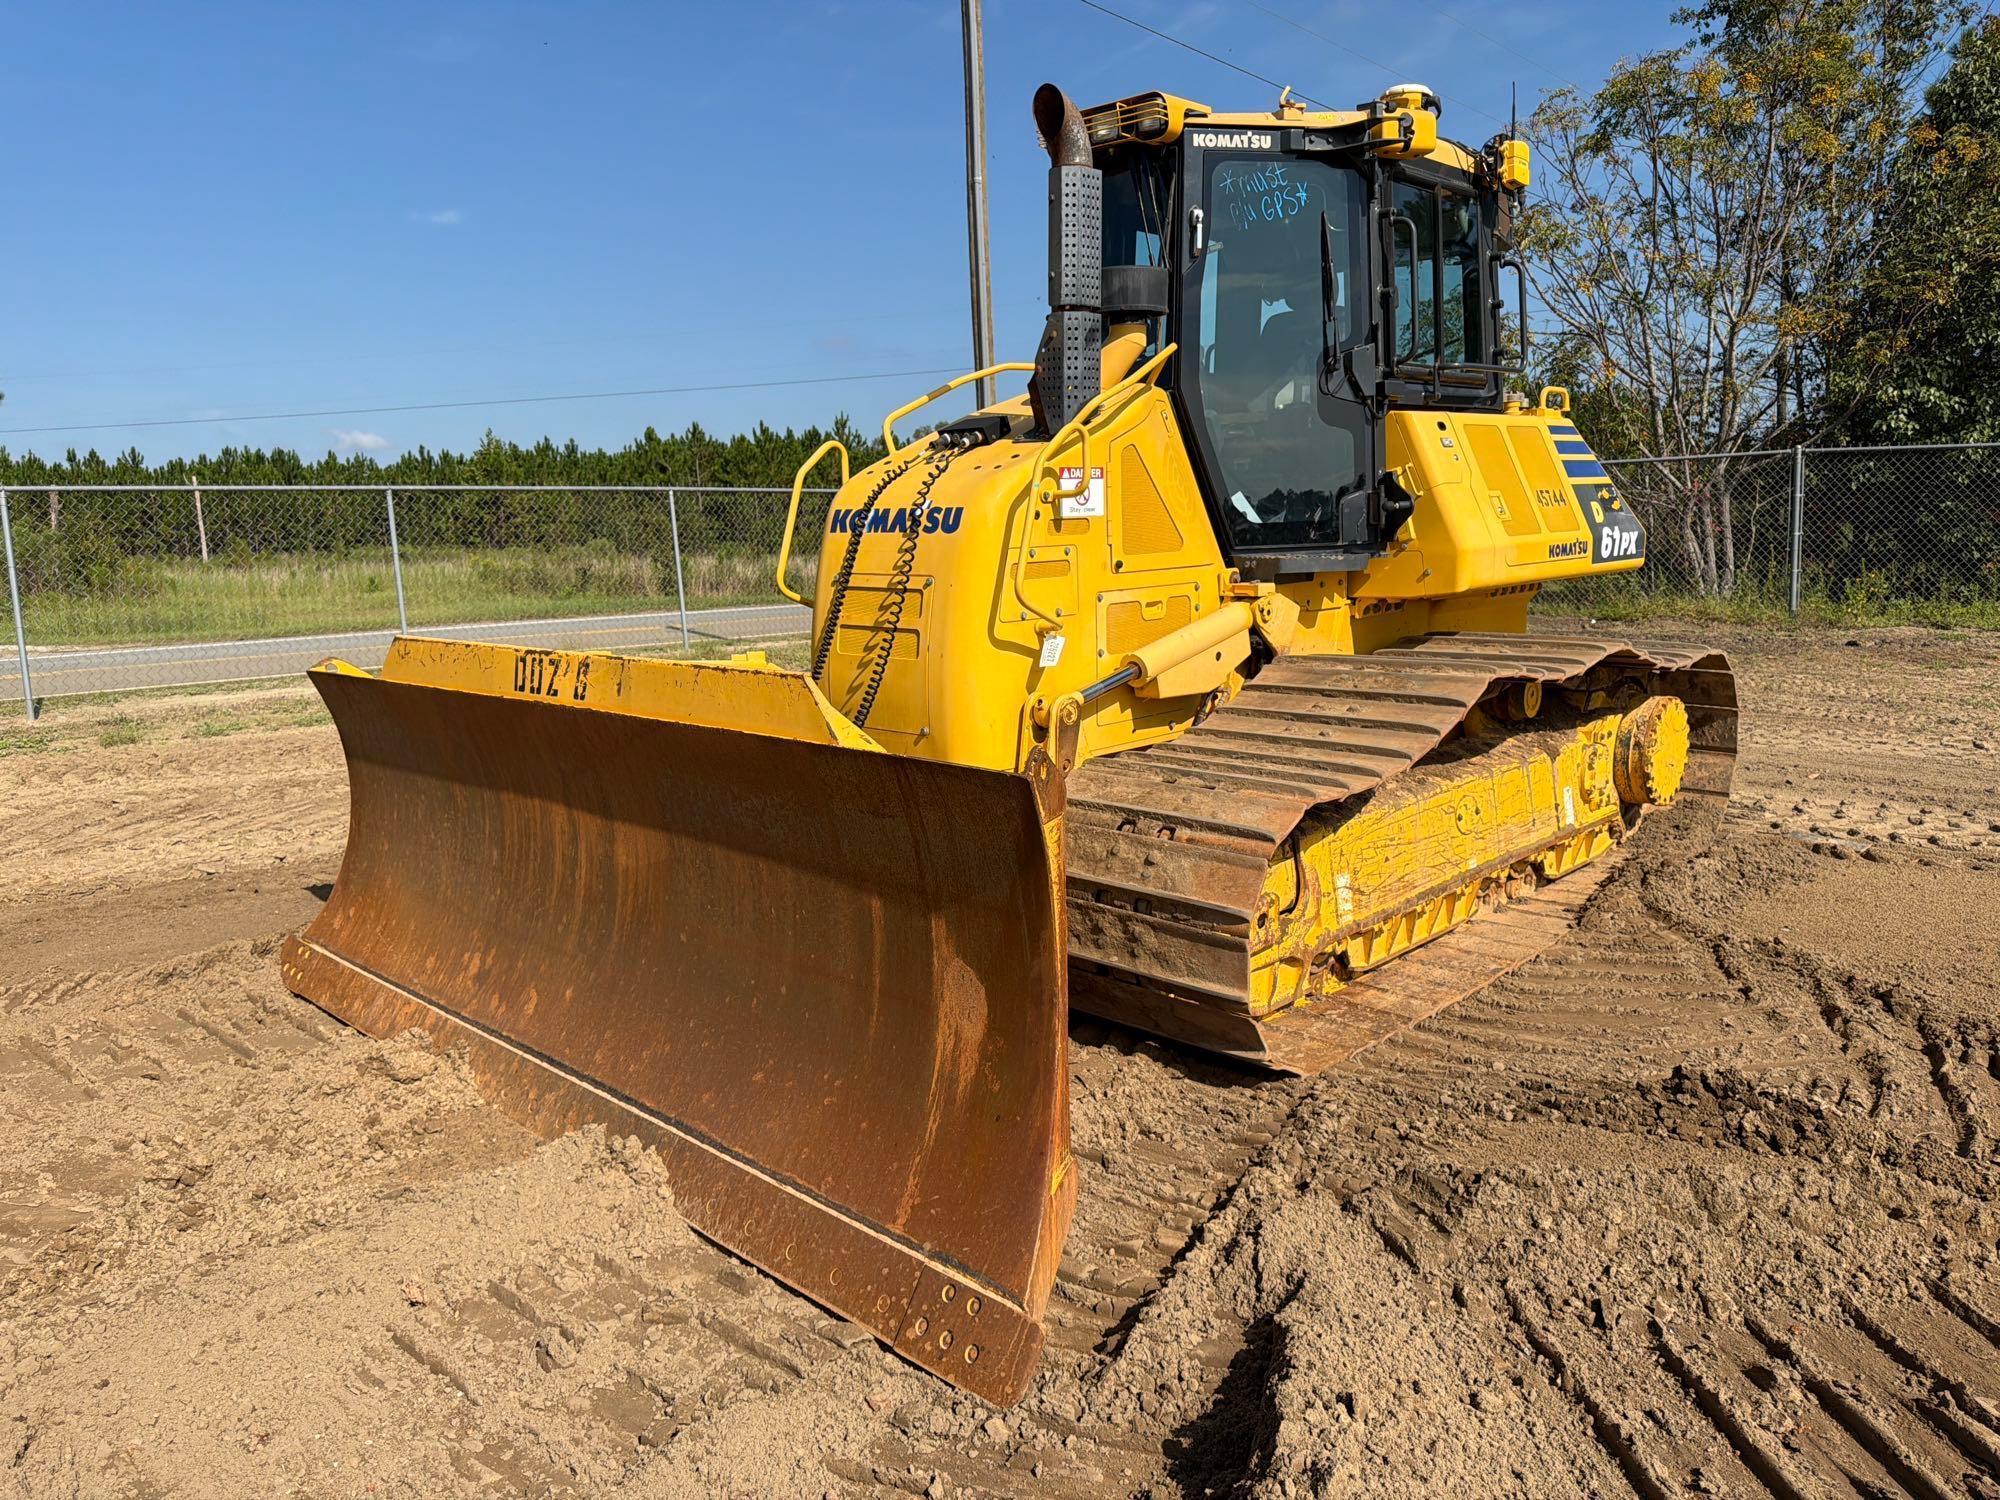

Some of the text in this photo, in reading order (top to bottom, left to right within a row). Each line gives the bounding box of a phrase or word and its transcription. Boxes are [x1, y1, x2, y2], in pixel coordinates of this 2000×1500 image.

[1193, 131, 1271, 149] KOMATSU
[1070, 468, 1102, 478] DAER
[1536, 489, 1566, 507] 45744
[1590, 501, 1604, 523] D
[1549, 538, 1588, 558] KOMATSU
[1601, 526, 1639, 558] 61PX
